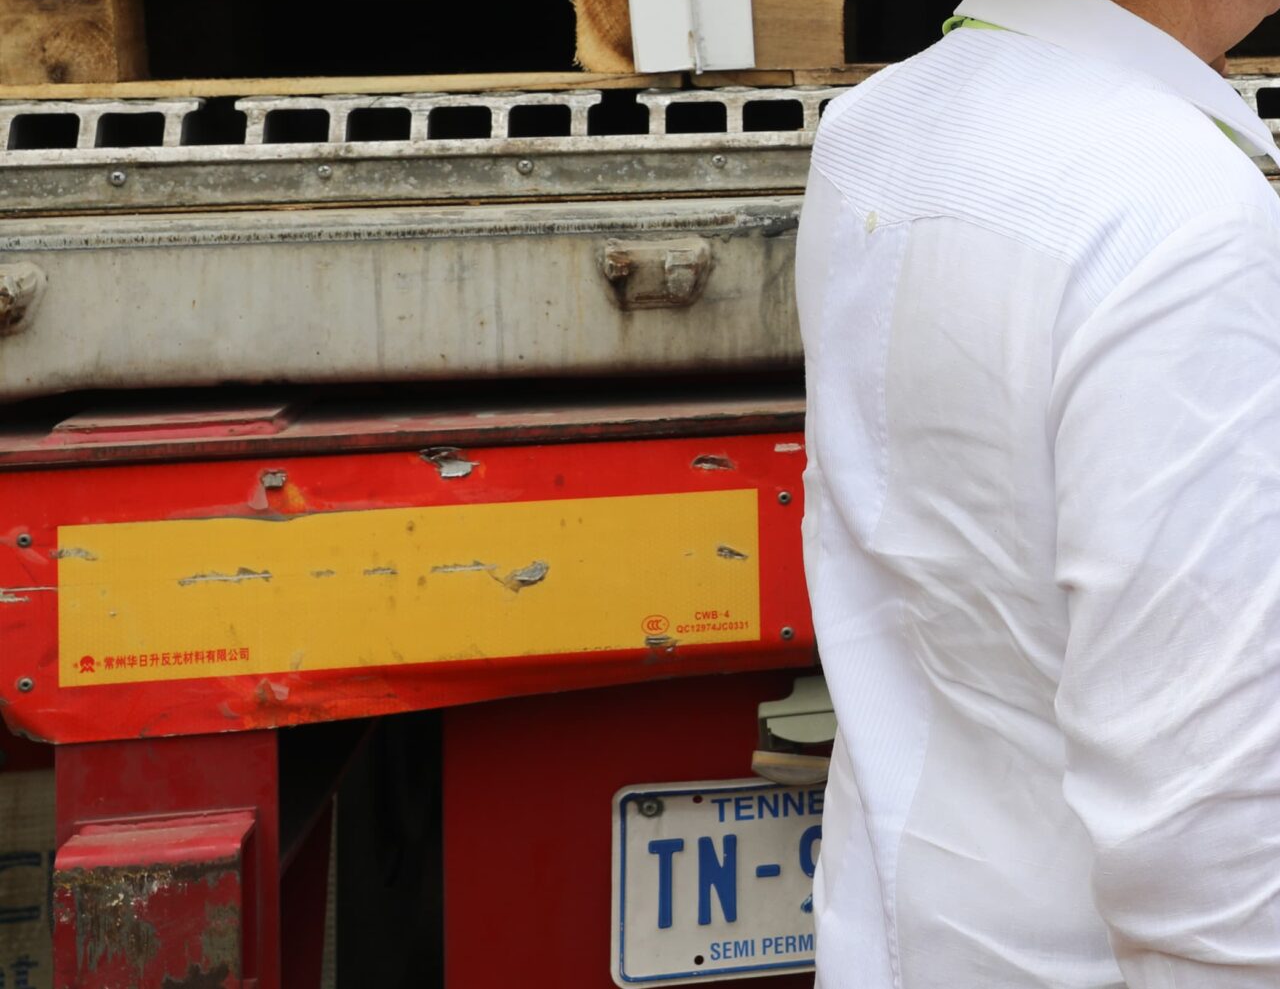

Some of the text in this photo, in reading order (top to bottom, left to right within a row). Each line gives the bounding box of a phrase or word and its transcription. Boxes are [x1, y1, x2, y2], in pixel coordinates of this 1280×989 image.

[711, 790, 826, 822] TENNE
[710, 933, 815, 961] SEMI PERM
